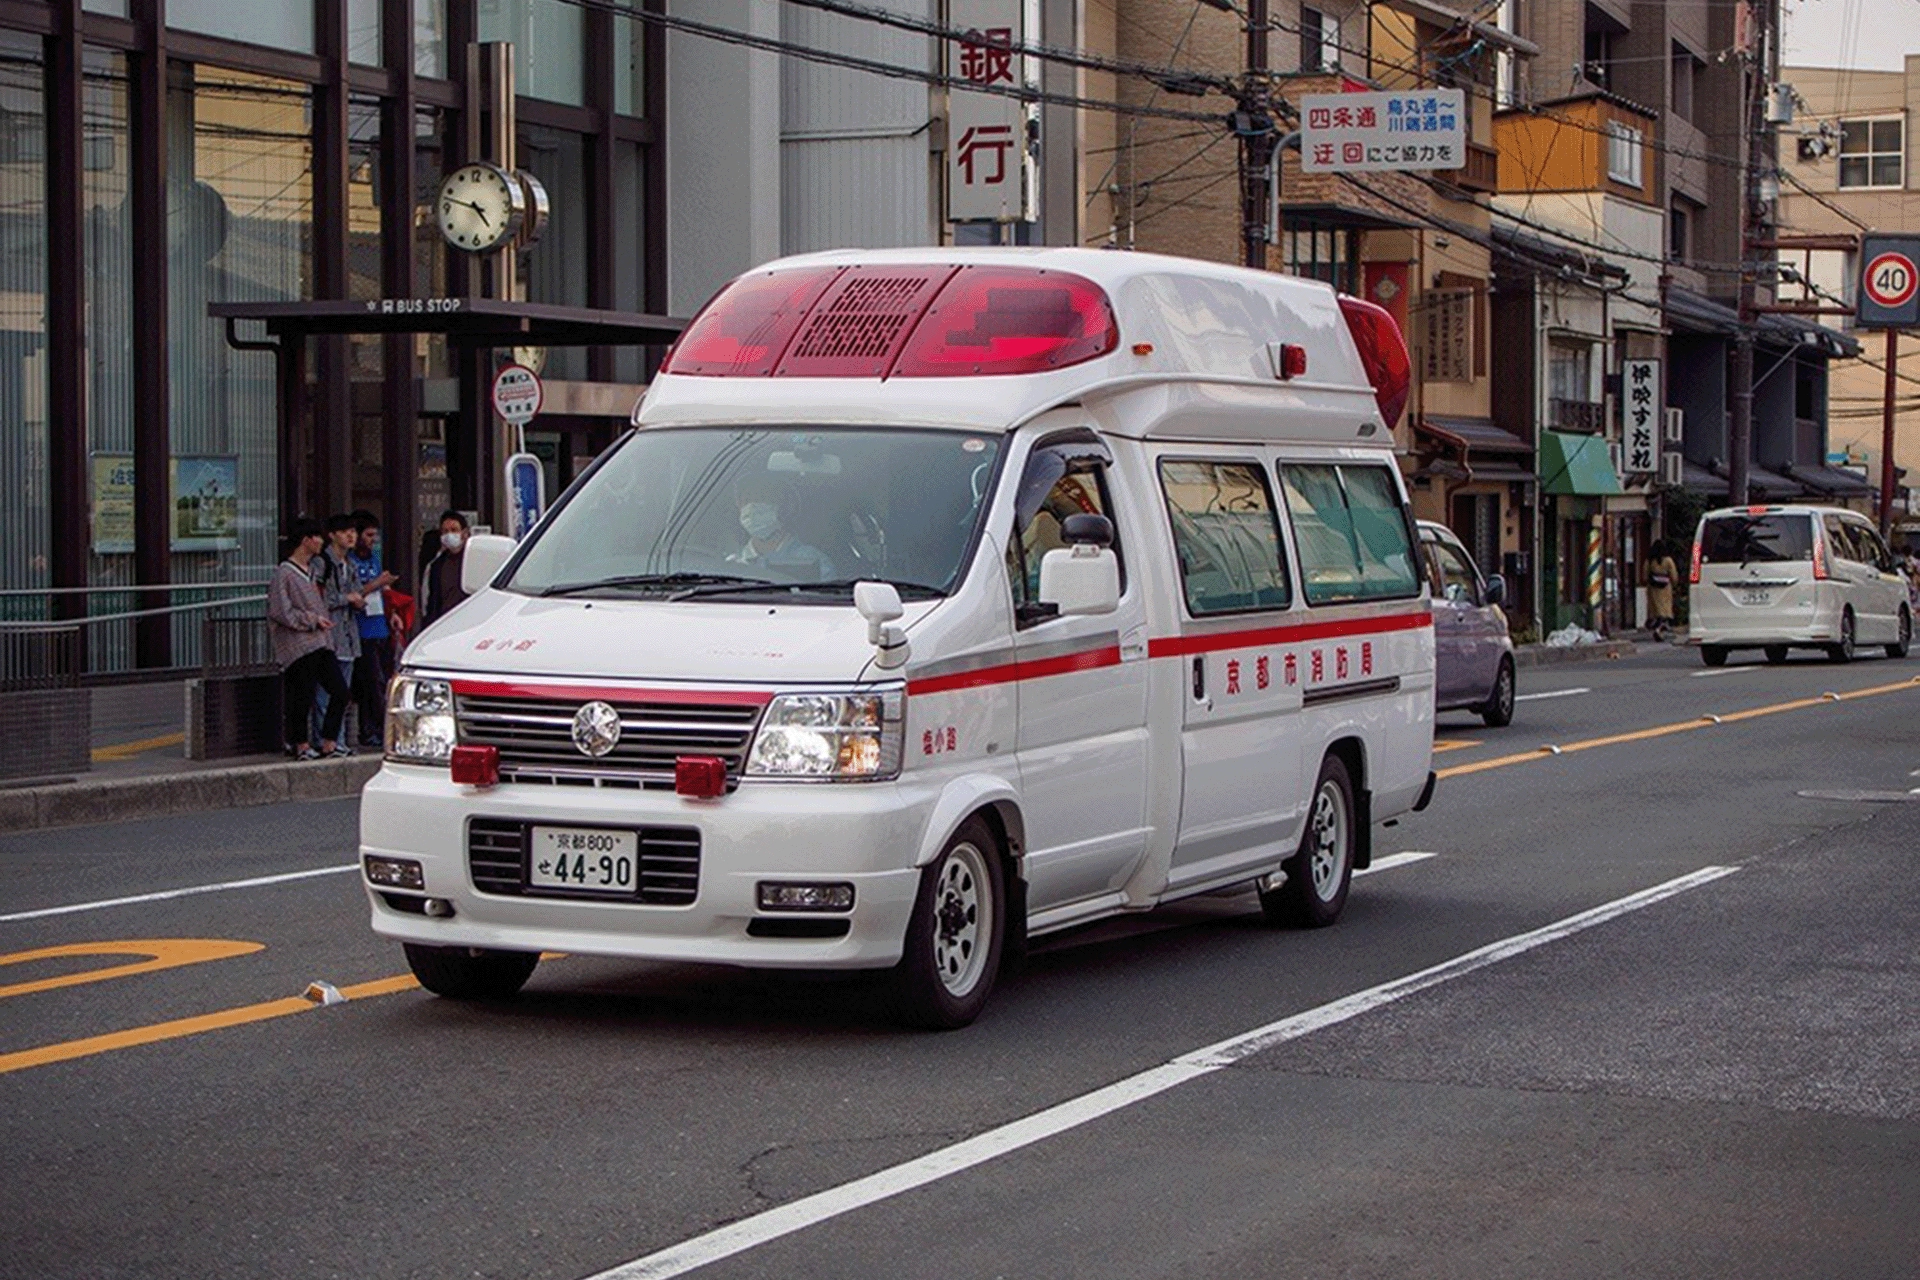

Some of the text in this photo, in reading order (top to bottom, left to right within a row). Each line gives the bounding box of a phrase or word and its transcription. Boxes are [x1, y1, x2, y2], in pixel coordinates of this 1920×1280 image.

[957, 28, 1014, 185] 銀行
[1309, 107, 1376, 130] 四条通
[472, 170, 480, 182] 12
[443, 202, 451, 215] 9
[472, 234, 481, 246] 6
[1876, 268, 1906, 291] 40
[396, 298, 461, 313] BUS STOP
[1631, 364, 1652, 468] 伊吹すだれ
[1226, 641, 1373, 695] 京都市消防局
[555, 853, 630, 886] 44-90
